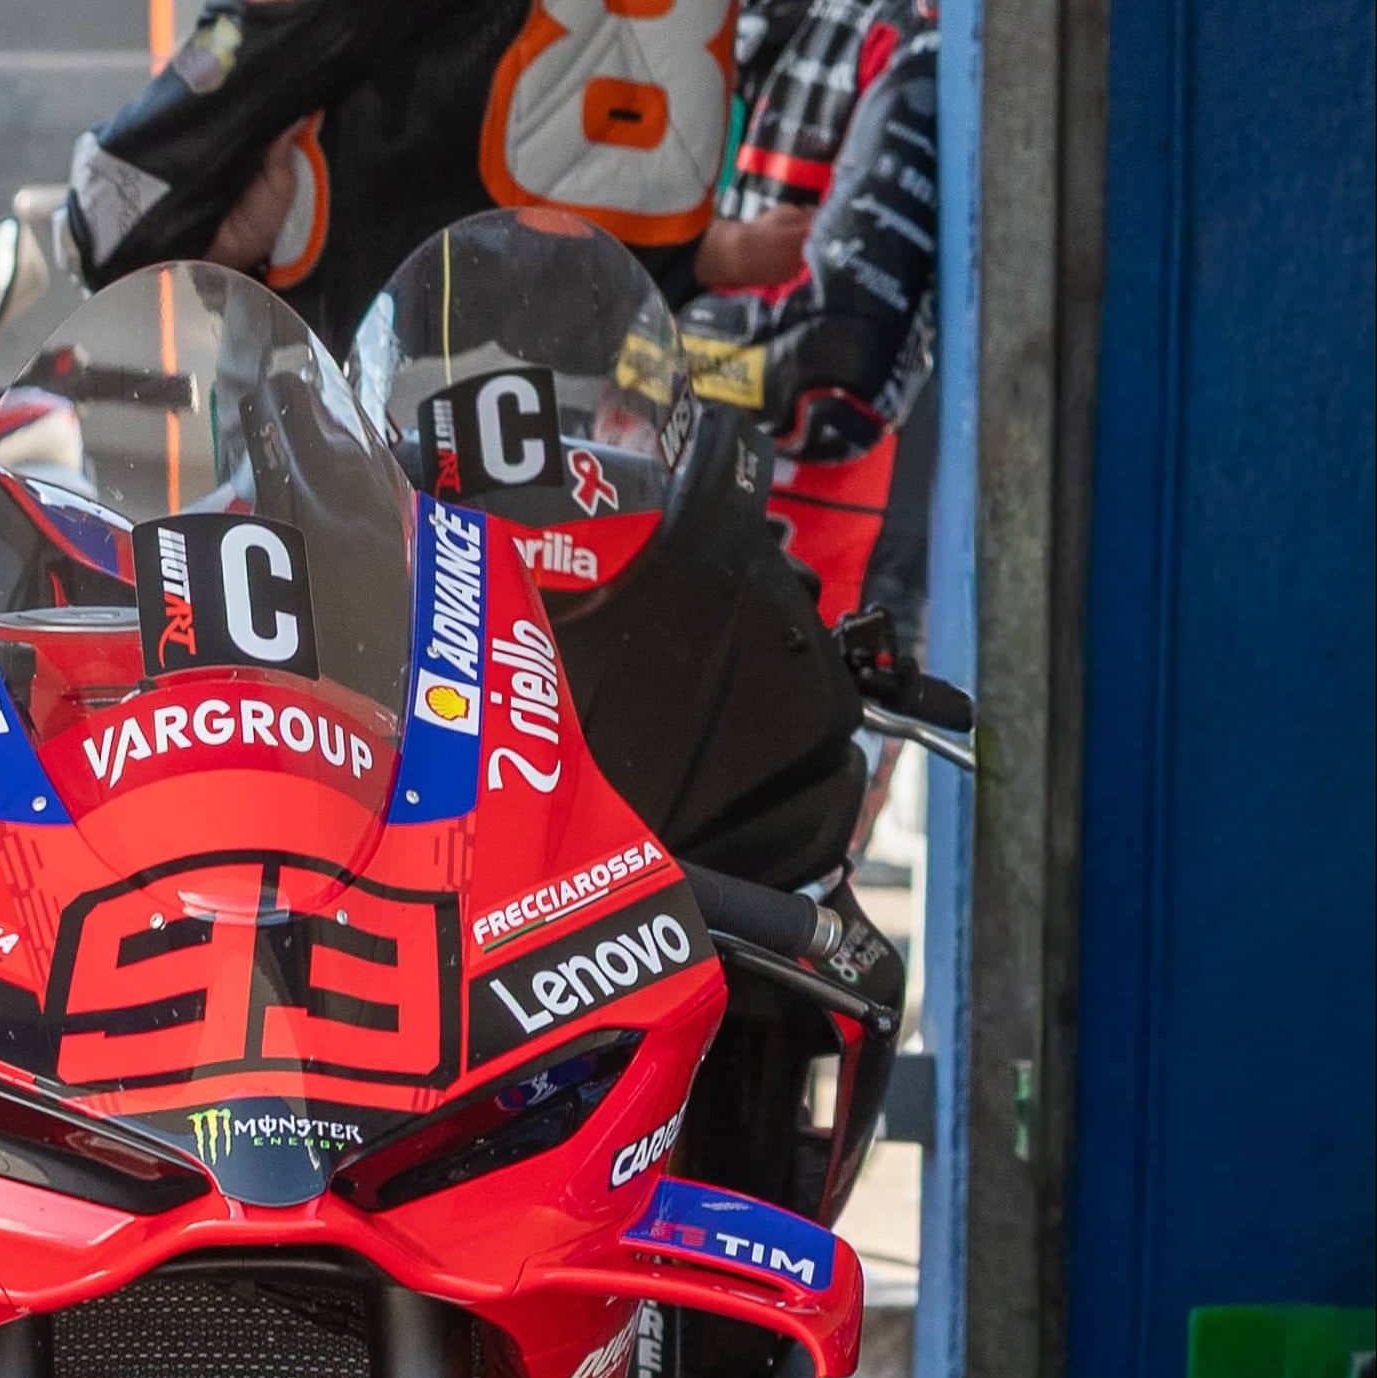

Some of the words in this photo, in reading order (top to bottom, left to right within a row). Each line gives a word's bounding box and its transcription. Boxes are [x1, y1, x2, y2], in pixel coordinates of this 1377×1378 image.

[477, 374, 546, 484] C
[220, 522, 300, 663] C
[430, 501, 481, 681] ADVANCE
[490, 618, 558, 745] riello
[82, 698, 373, 790] VARGROUP
[473, 840, 664, 946] FRECCIAROSSA
[54, 855, 454, 1090] 93
[488, 913, 691, 1035] Lenovo
[233, 1114, 364, 1145] MONSTER
[253, 1136, 348, 1152] ENERGY
[716, 1231, 815, 1285] TIM
